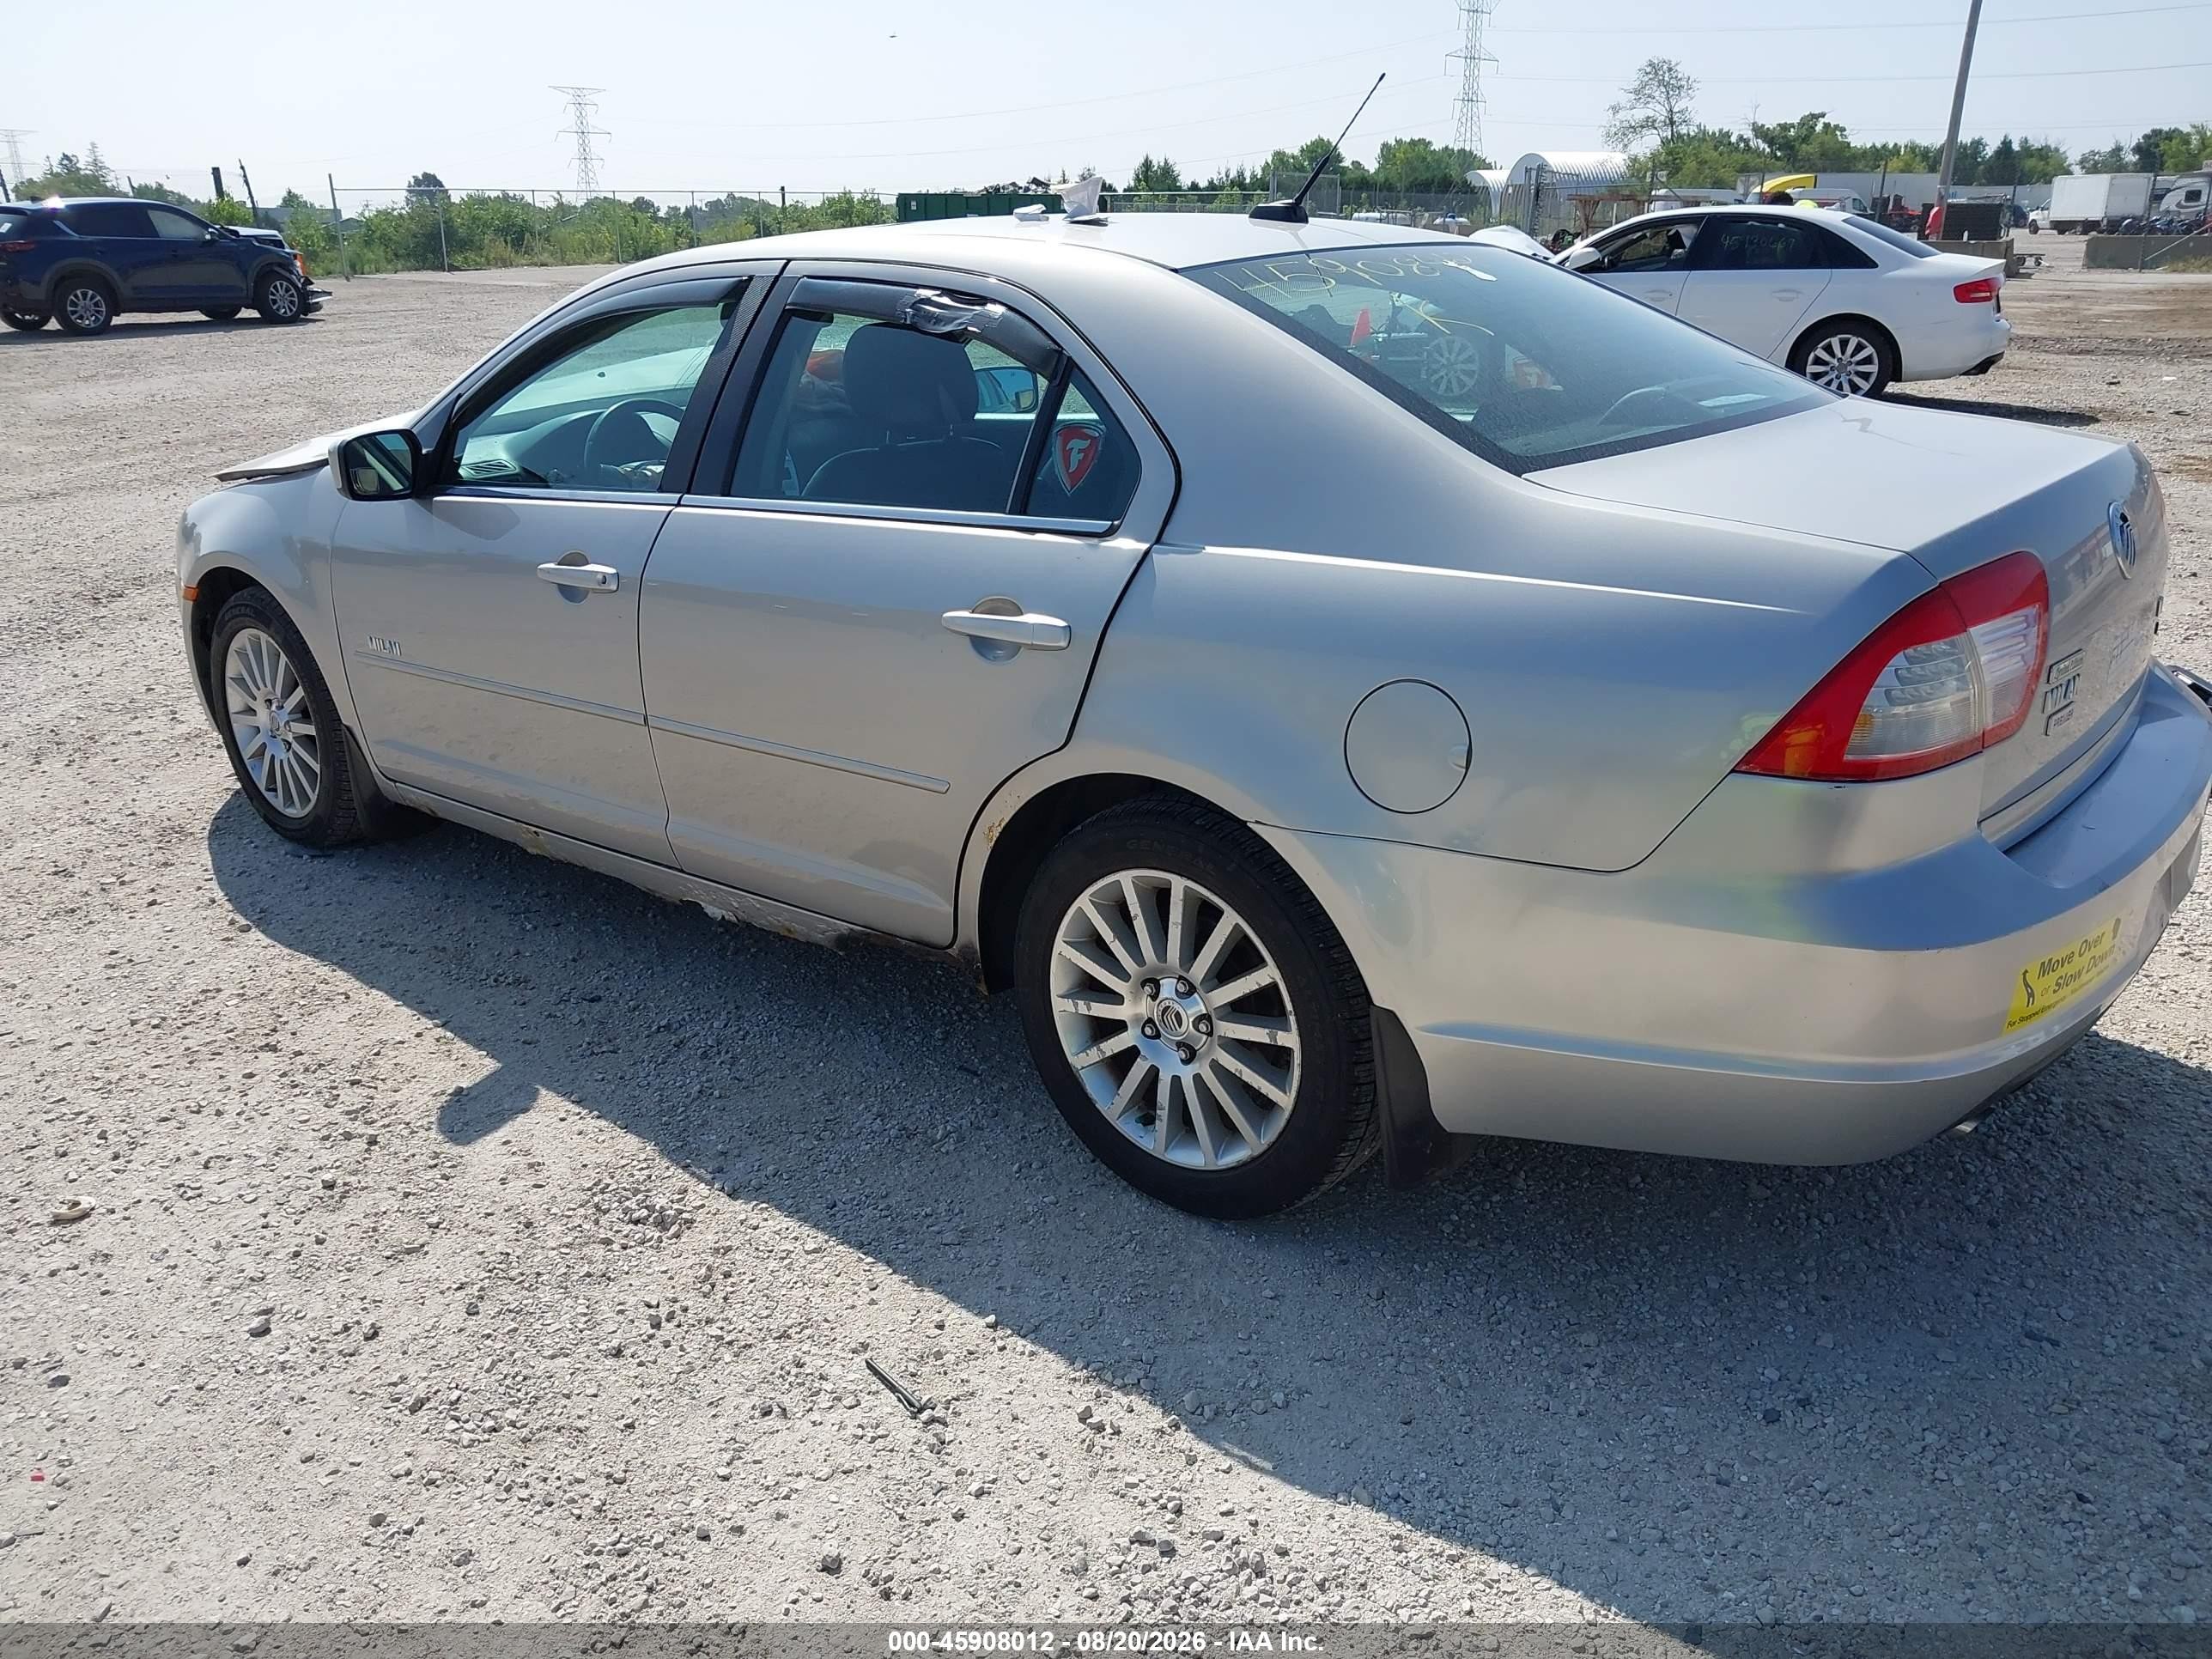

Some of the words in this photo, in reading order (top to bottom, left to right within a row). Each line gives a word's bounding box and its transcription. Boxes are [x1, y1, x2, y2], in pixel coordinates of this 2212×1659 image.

[2038, 951, 2075, 980] Move
[2078, 932, 2106, 957] Over
[2040, 986, 2051, 997] or
[2052, 967, 2085, 994] Slow
[2086, 945, 2116, 974] Down
